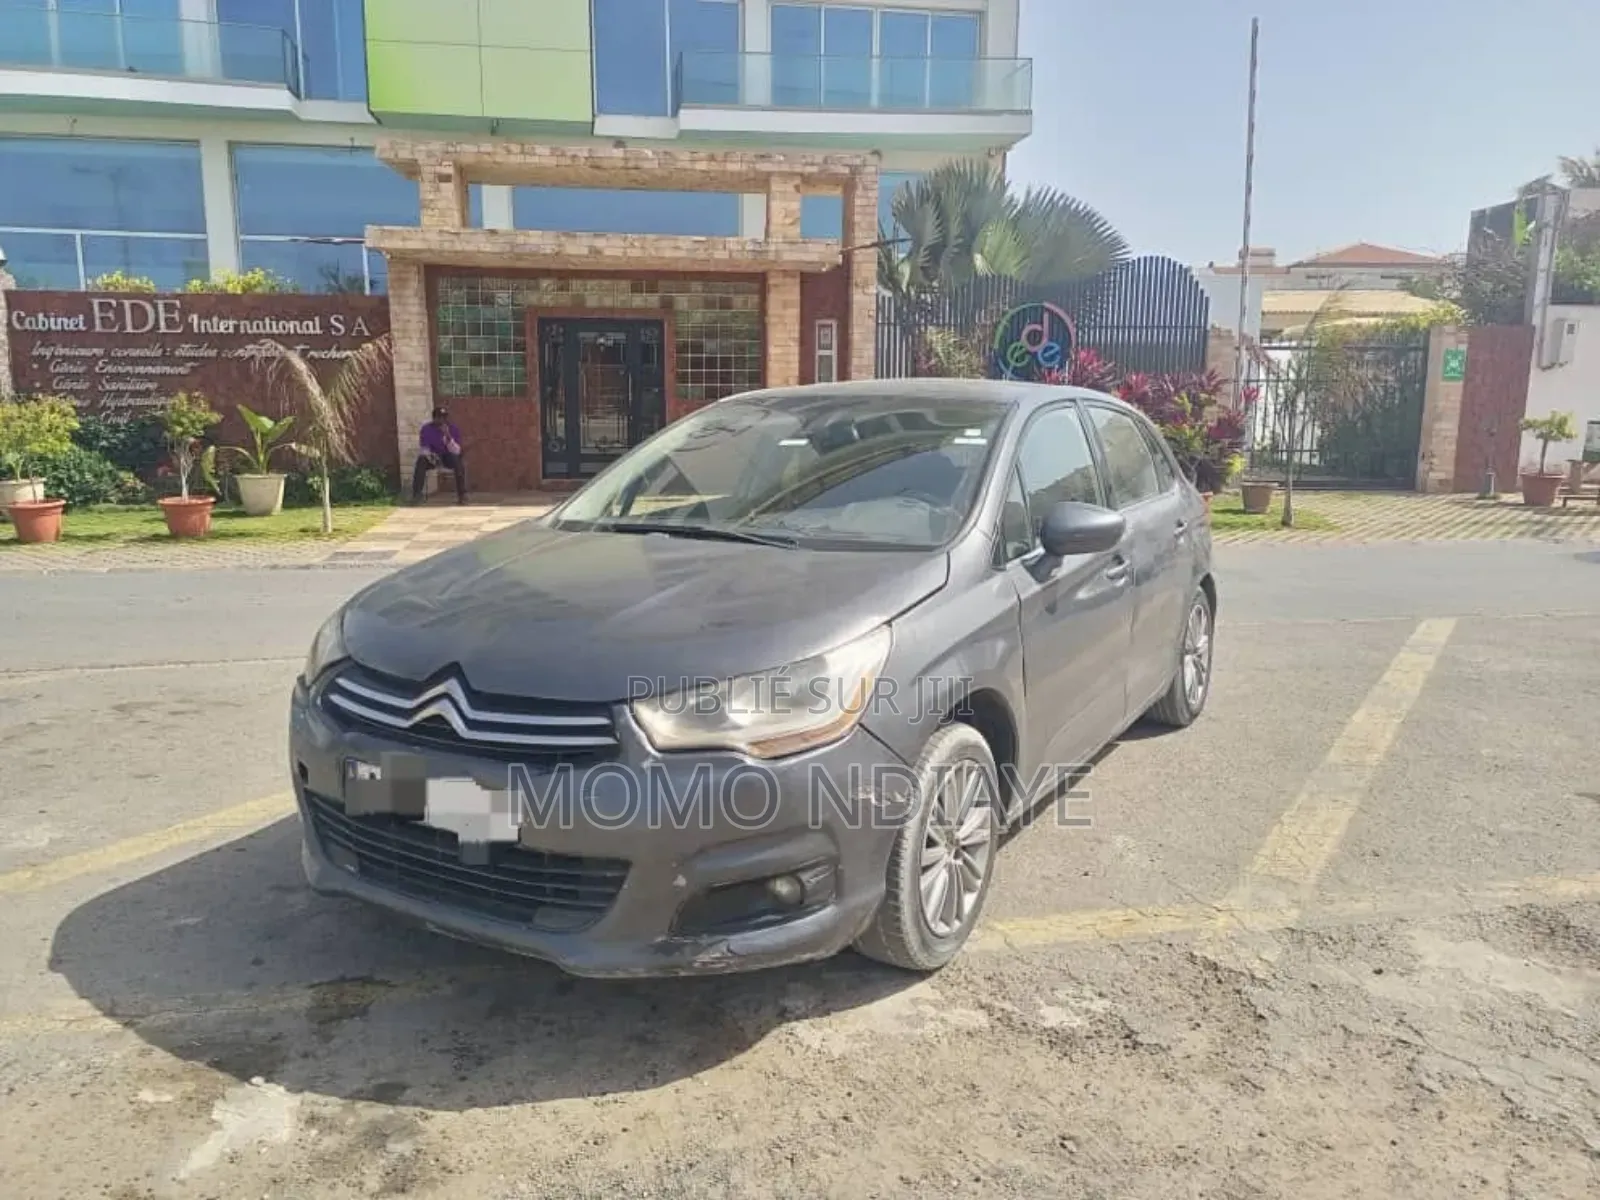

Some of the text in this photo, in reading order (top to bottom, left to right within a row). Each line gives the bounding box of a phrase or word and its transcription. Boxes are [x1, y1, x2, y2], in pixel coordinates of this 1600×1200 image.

[11, 298, 372, 337] Cabinet EDE International S A
